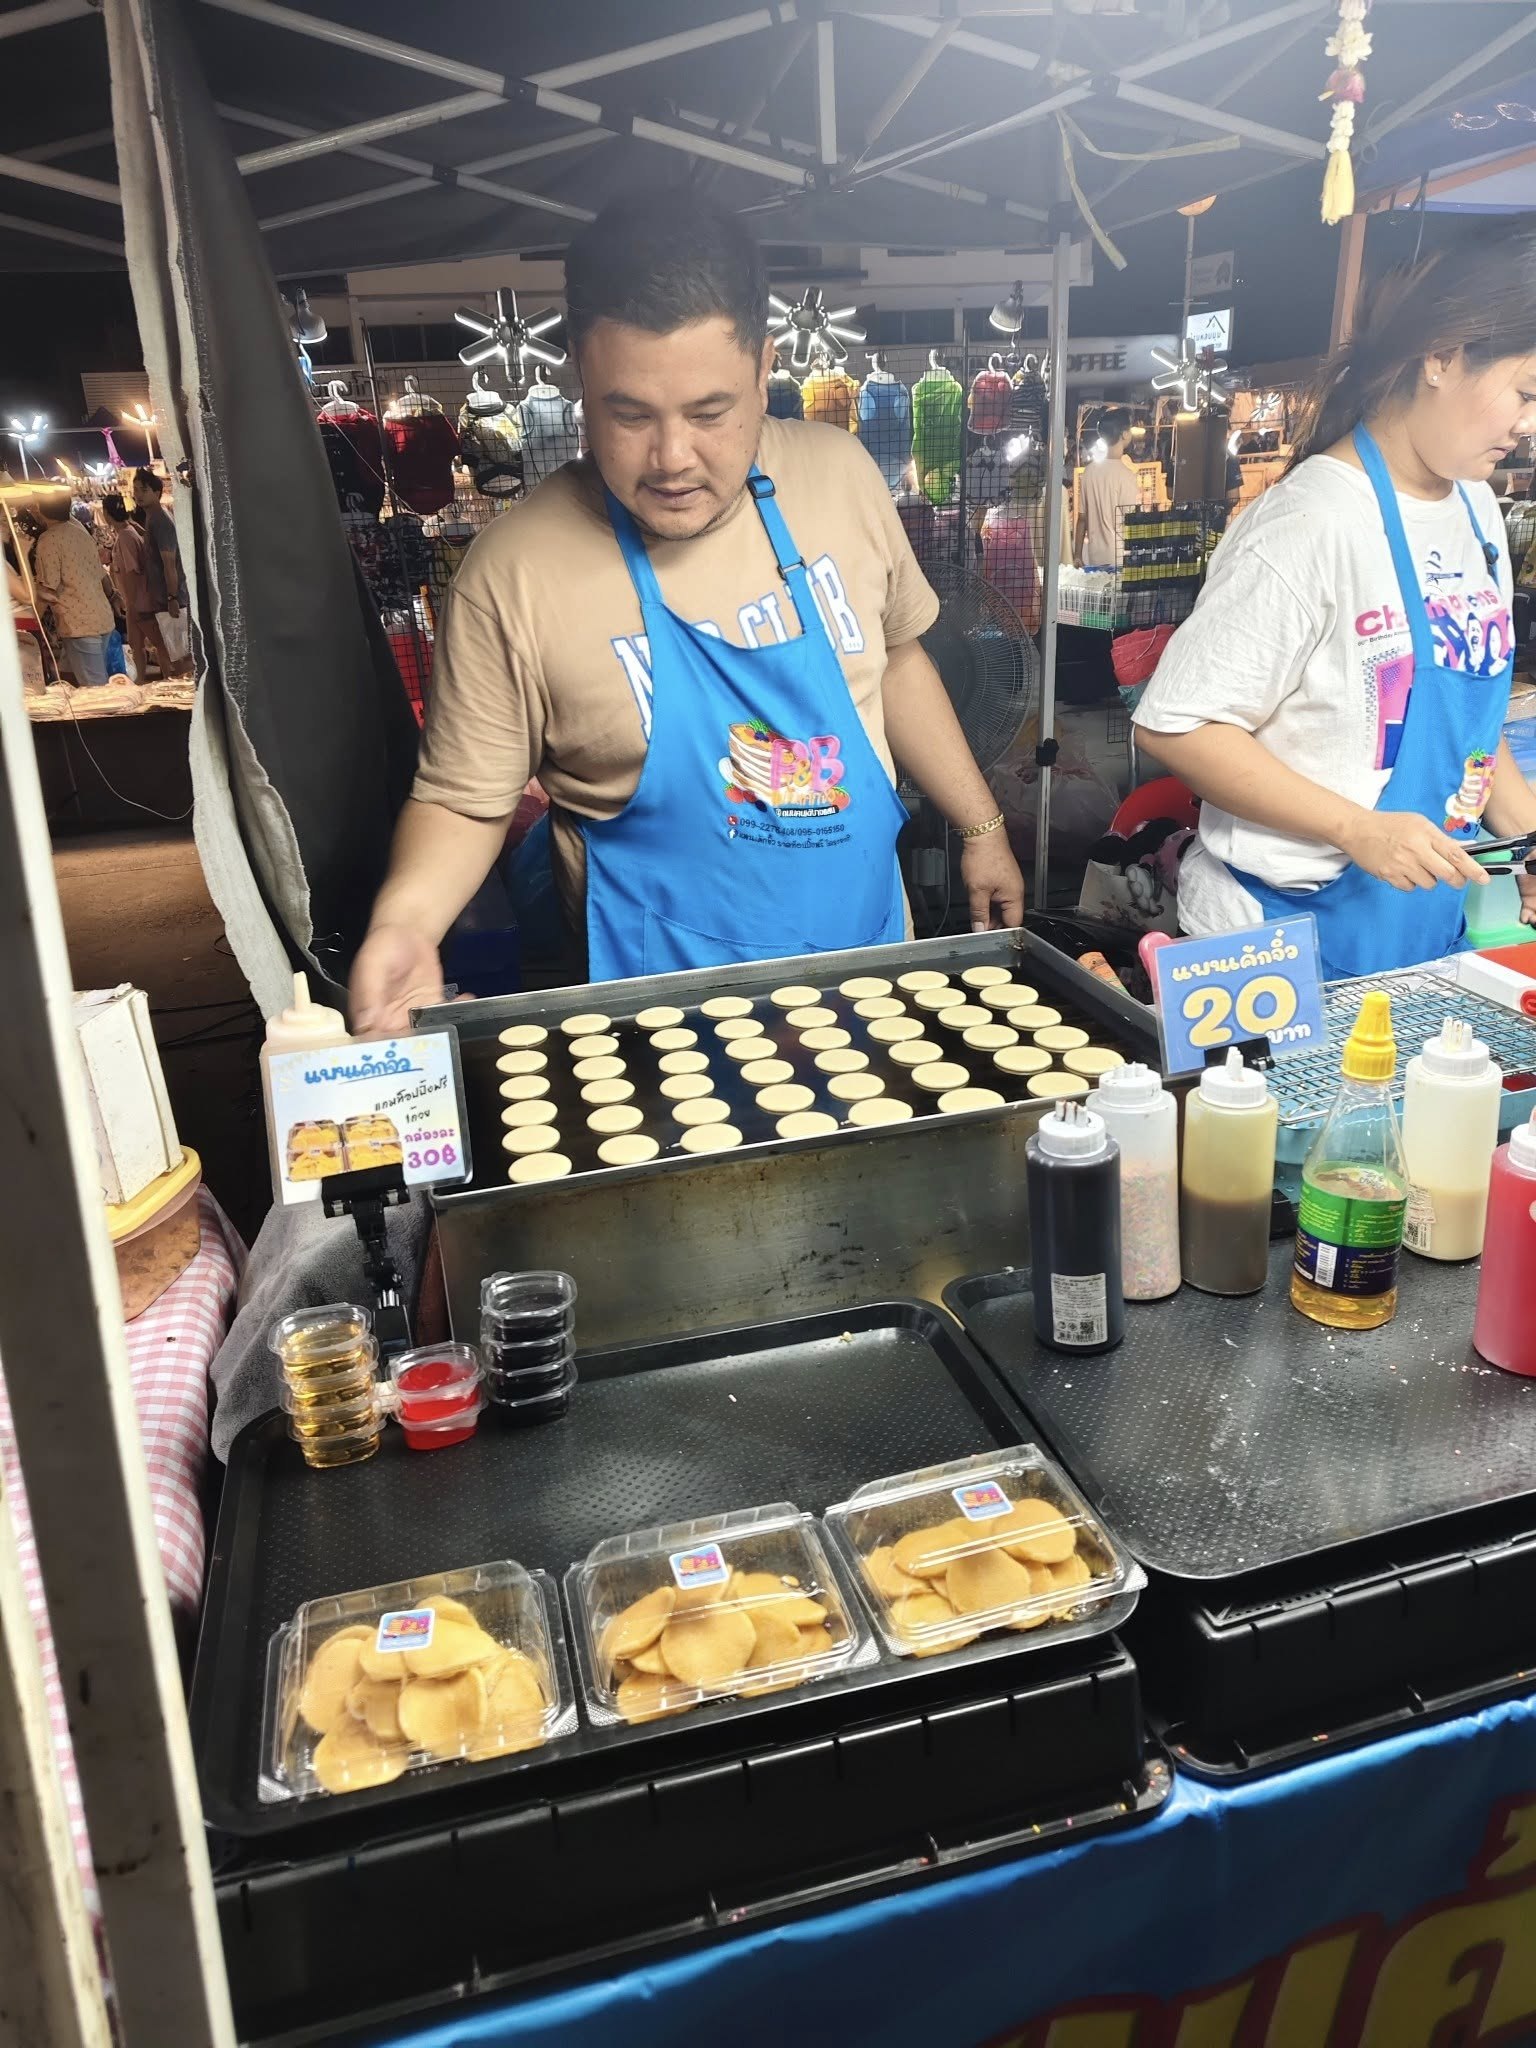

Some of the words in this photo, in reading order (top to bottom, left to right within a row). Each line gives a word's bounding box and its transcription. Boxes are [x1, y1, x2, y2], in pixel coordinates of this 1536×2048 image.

[1067, 351, 1127, 371] OFFEE
[1172, 928, 1299, 981] แพนเค้กจิ๋ว
[1182, 975, 1297, 1047] 20
[1265, 1023, 1312, 1044] บาท
[304, 1041, 411, 1084] แพนเค้กจิ๋ว
[404, 1126, 456, 1143] กล่องละ
